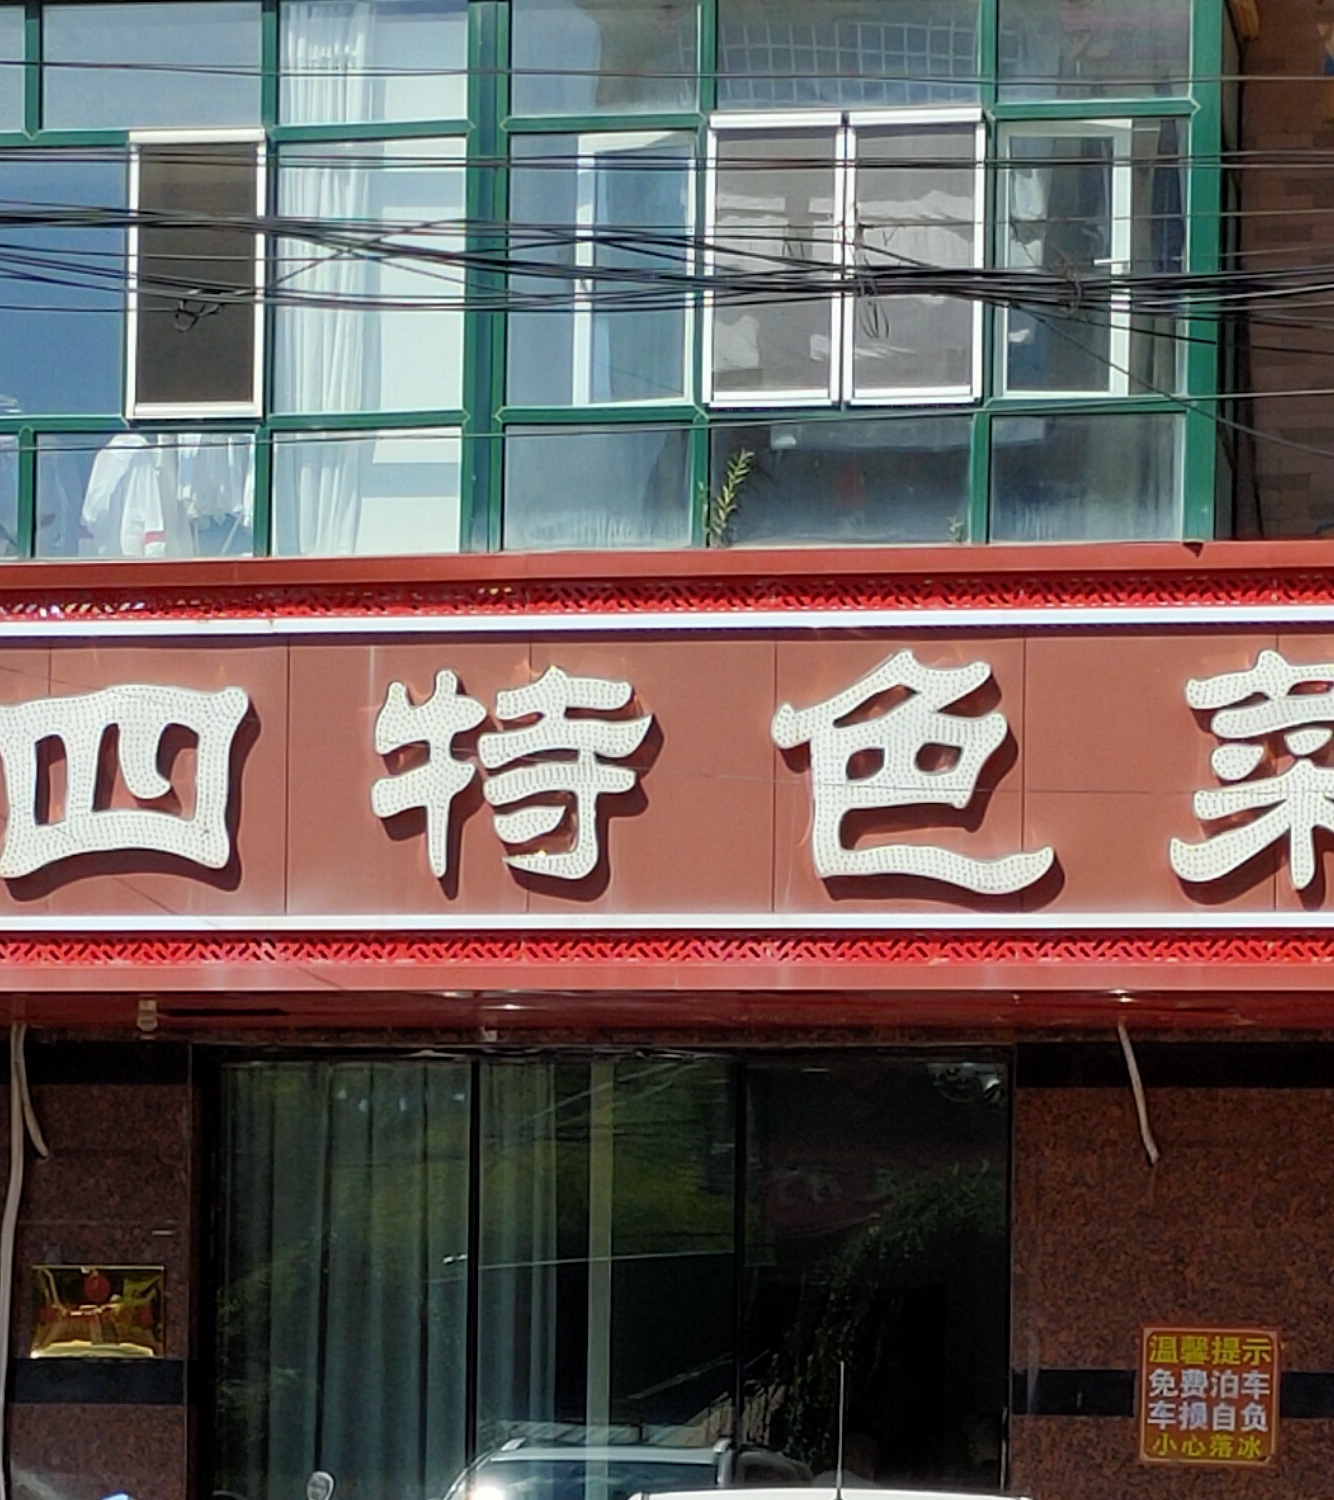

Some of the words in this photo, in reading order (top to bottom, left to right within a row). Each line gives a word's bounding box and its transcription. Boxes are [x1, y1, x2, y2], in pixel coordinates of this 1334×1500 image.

[1150, 1335, 1271, 1365] 温馨提示
[1149, 1369, 1270, 1400] 免费泊车
[1148, 1402, 1267, 1432] 车损自负
[1153, 1434, 1261, 1458] 小心落冰
